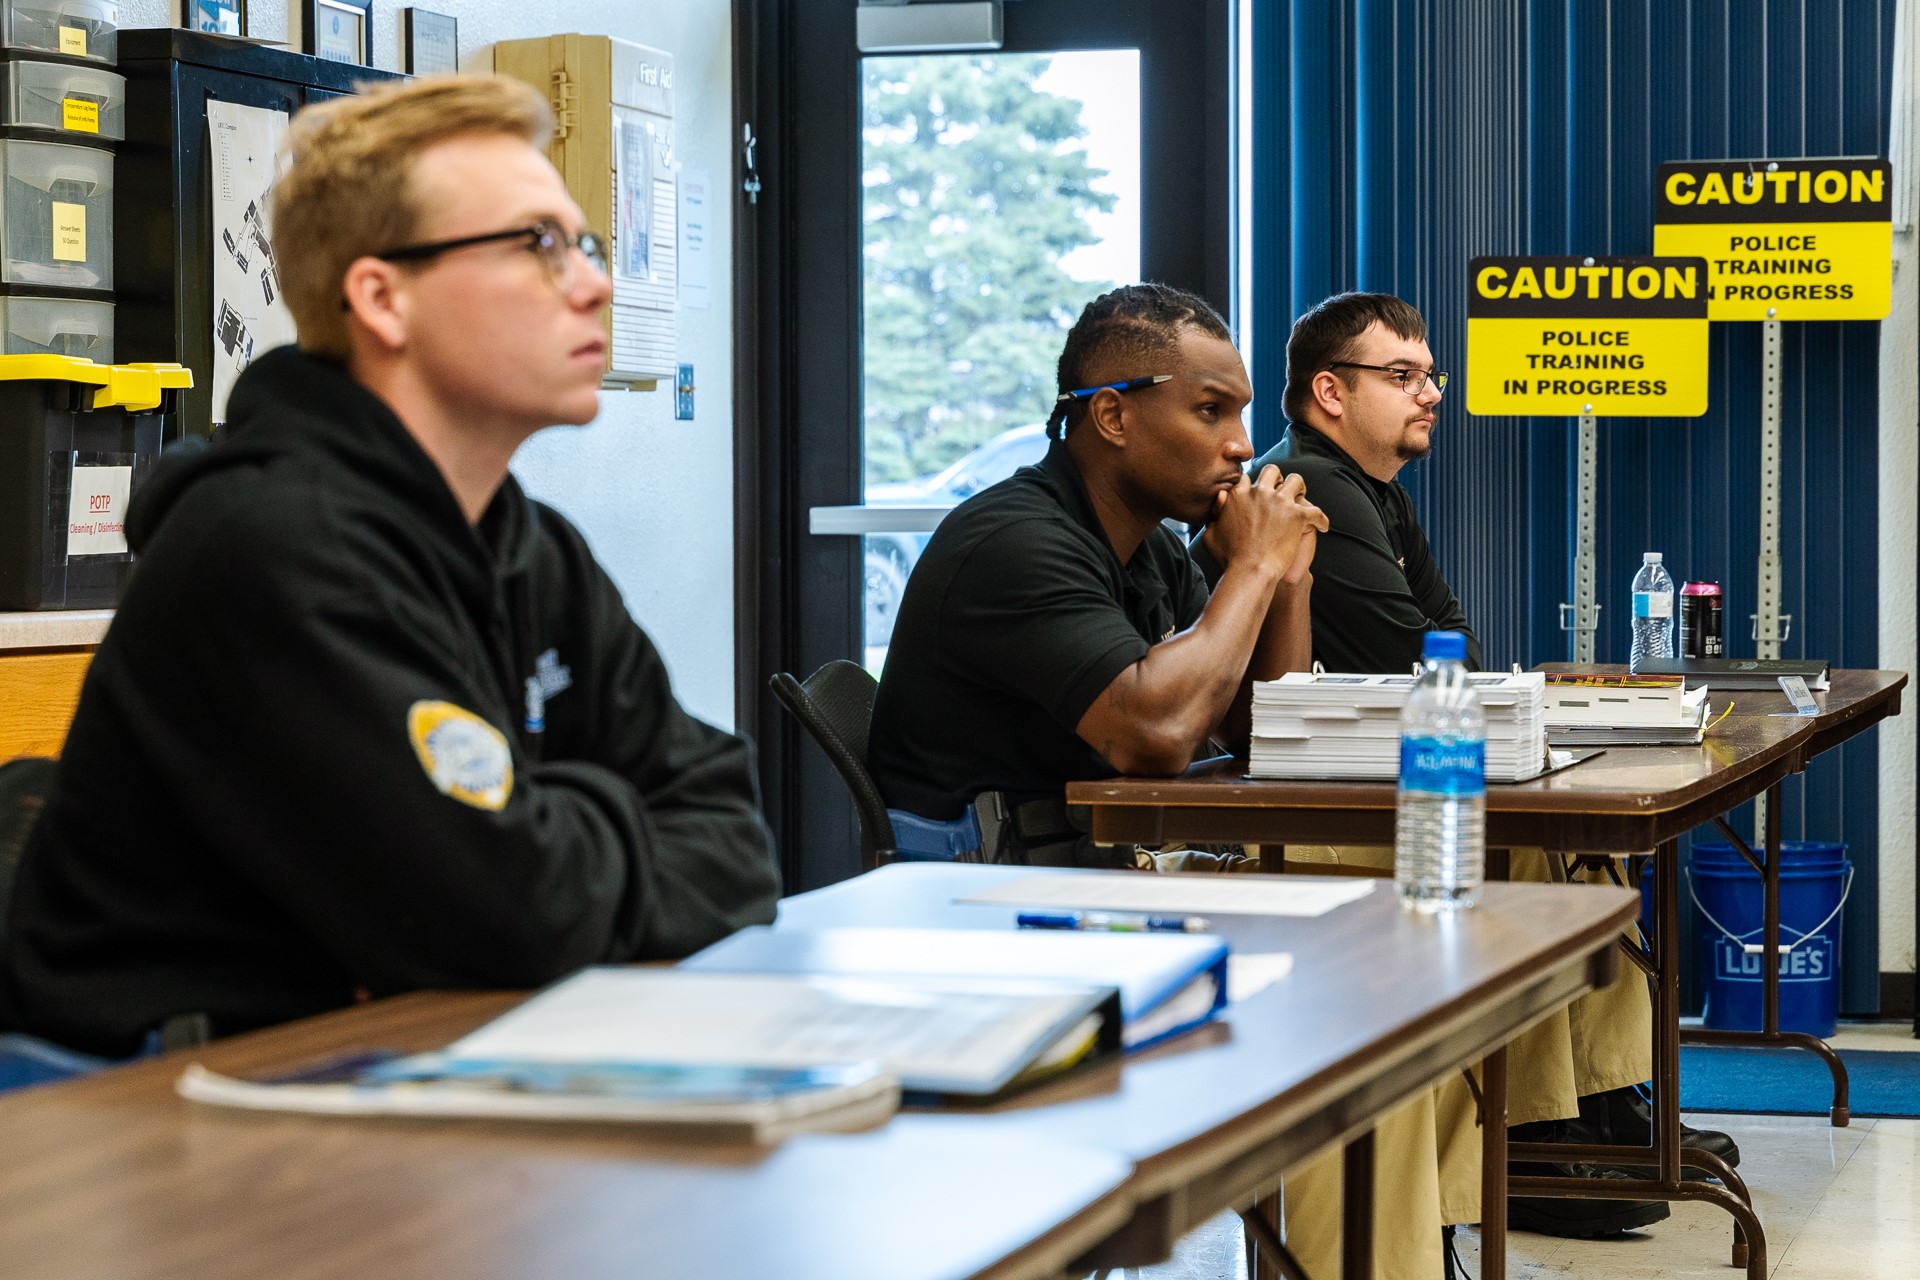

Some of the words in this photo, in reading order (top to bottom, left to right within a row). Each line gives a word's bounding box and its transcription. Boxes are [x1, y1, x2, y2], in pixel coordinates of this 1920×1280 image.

[639, 61, 657, 86] First
[1665, 170, 1883, 205] CAUTION
[1730, 236, 1816, 251] POLICE
[1714, 259, 1831, 275] TRAINING
[1476, 266, 1696, 299] CAUTION
[1725, 284, 1854, 300] PROGRESS
[1542, 331, 1629, 346] POLICE
[1526, 354, 1645, 370] TRAINING
[1504, 380, 1527, 395] IN
[1537, 379, 1667, 396] PROGRESS
[90, 495, 111, 510] POTP
[70, 523, 93, 536] Cleaning
